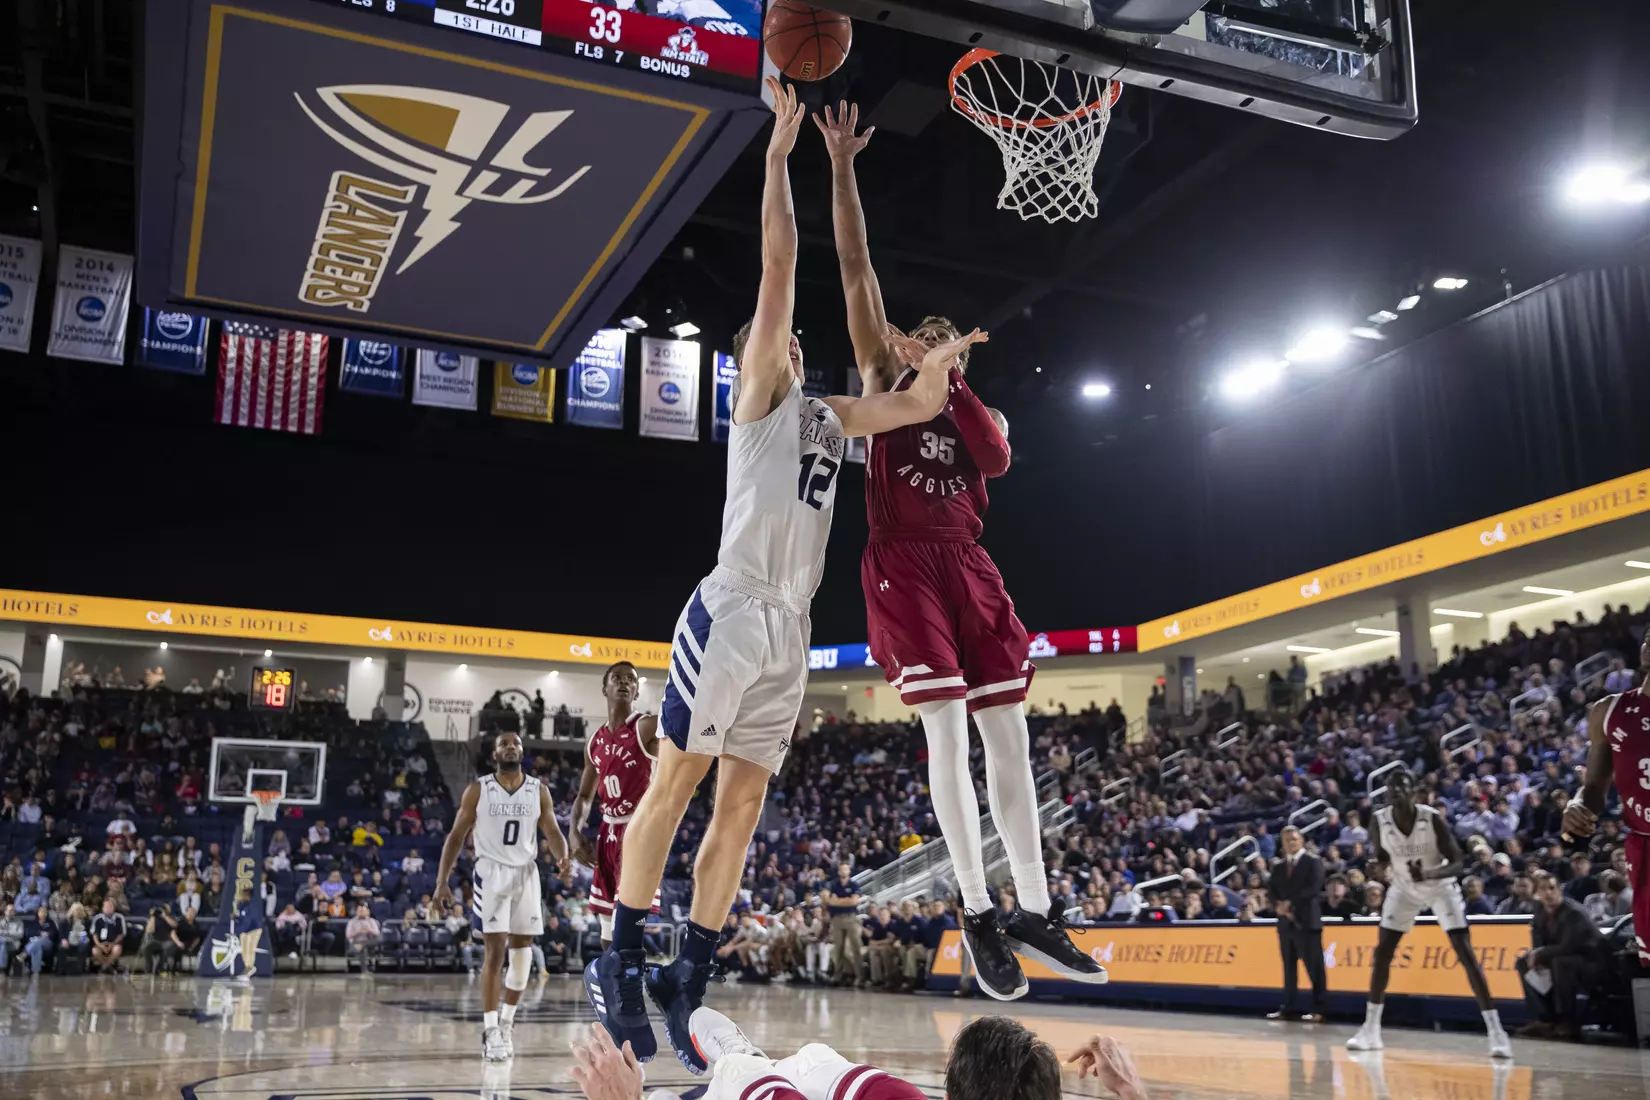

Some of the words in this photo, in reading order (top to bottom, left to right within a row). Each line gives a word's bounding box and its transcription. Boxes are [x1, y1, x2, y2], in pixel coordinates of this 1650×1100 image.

[453, 15, 480, 30] 1ST
[490, 25, 530, 41] HALF
[589, 7, 622, 43] 33
[575, 41, 604, 59] FLS
[615, 50, 624, 63] 7
[640, 56, 691, 78] BONUS
[298, 171, 418, 313] LANCERS
[74, 256, 115, 274] 2014
[567, 397, 621, 411] CHAMPIONS
[920, 431, 956, 466] 35
[798, 453, 839, 512] 12
[896, 464, 967, 496] AGGIES
[1509, 507, 1564, 537] AYRES
[1570, 482, 1648, 520] HOTELS
[2, 598, 80, 617] HOTELS
[176, 612, 233, 628] AYRES
[239, 617, 309, 634] HOTELS
[395, 630, 448, 645] AYRES
[453, 633, 516, 650] HOTELS
[262, 669, 291, 686] 2:26
[265, 683, 286, 707] 18
[428, 697, 474, 707] EQUIPPED
[429, 704, 441, 713] TO
[443, 706, 471, 715] SERVE
[604, 743, 637, 769] STATE
[603, 774, 621, 799] 10
[502, 819, 520, 846] 0
[1113, 944, 1163, 963] AYRES
[1166, 944, 1238, 964] HOTELS
